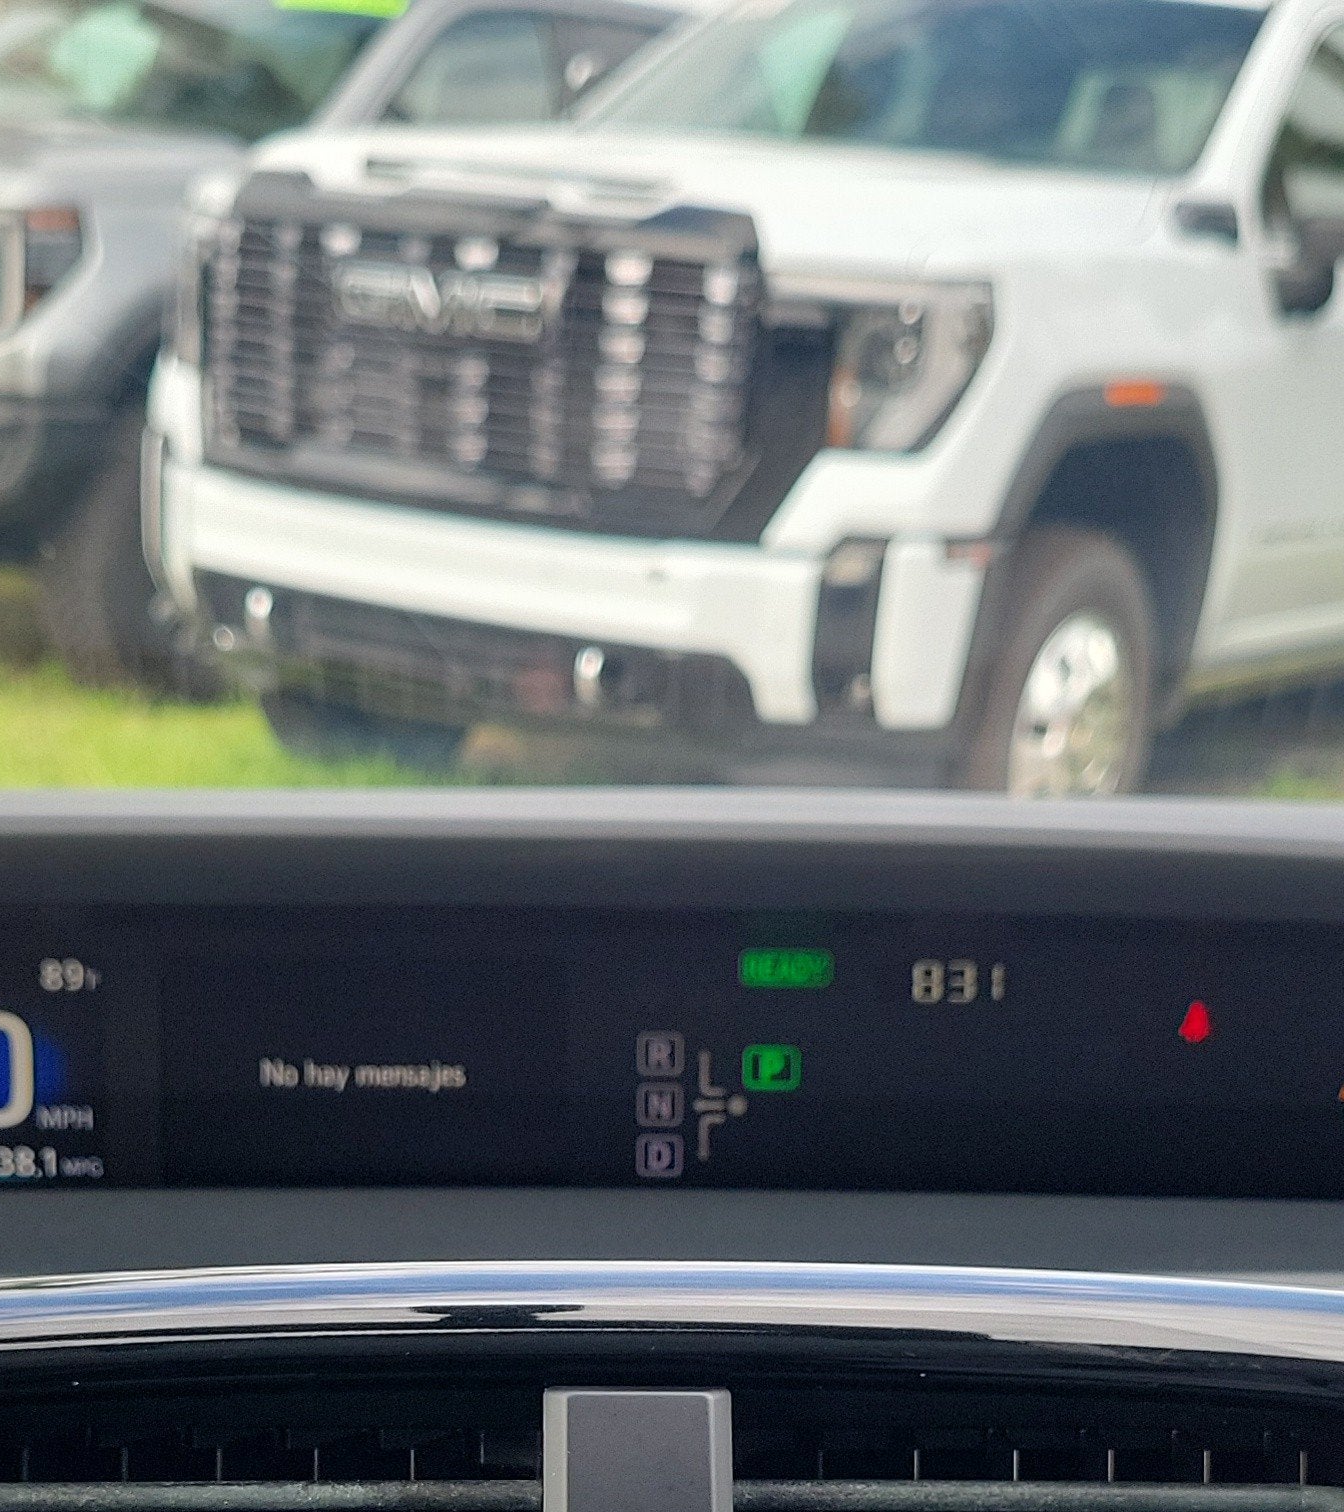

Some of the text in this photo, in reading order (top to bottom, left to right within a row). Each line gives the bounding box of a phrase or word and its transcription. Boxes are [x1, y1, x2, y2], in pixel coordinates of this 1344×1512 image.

[331, 261, 542, 342] GMC
[259, 1056, 468, 1093] No hay mensajes
[35, 1106, 93, 1130] MPH
